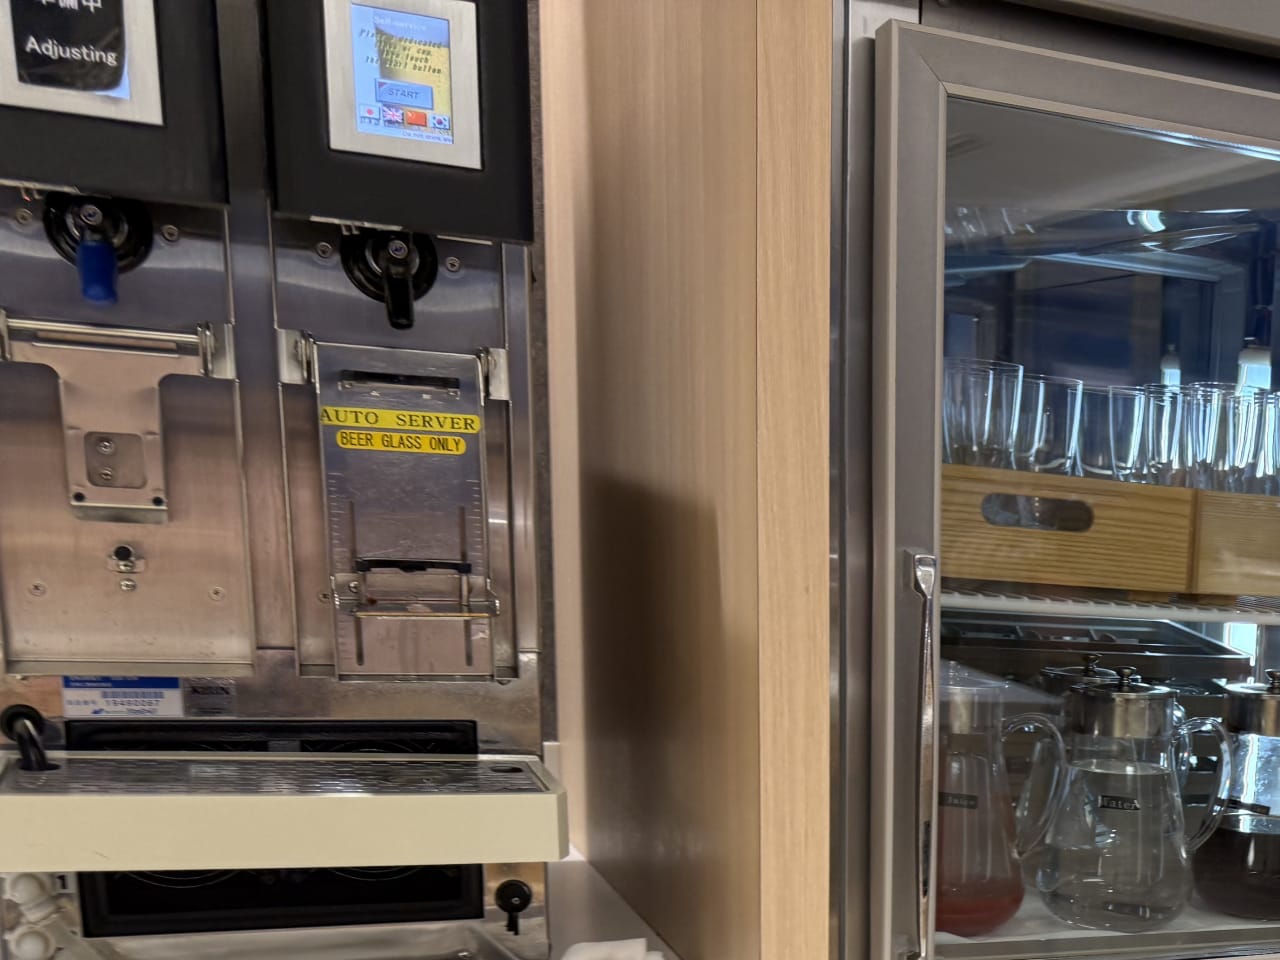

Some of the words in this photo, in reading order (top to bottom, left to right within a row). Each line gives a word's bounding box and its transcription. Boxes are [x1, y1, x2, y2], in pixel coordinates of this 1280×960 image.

[25, 35, 119, 67] Adjusting
[388, 88, 421, 100] START
[320, 408, 379, 425] AUTO
[396, 413, 476, 431] SERVER
[340, 431, 374, 447] BEER
[381, 434, 422, 450] GLASS
[429, 436, 461, 452] ONLY
